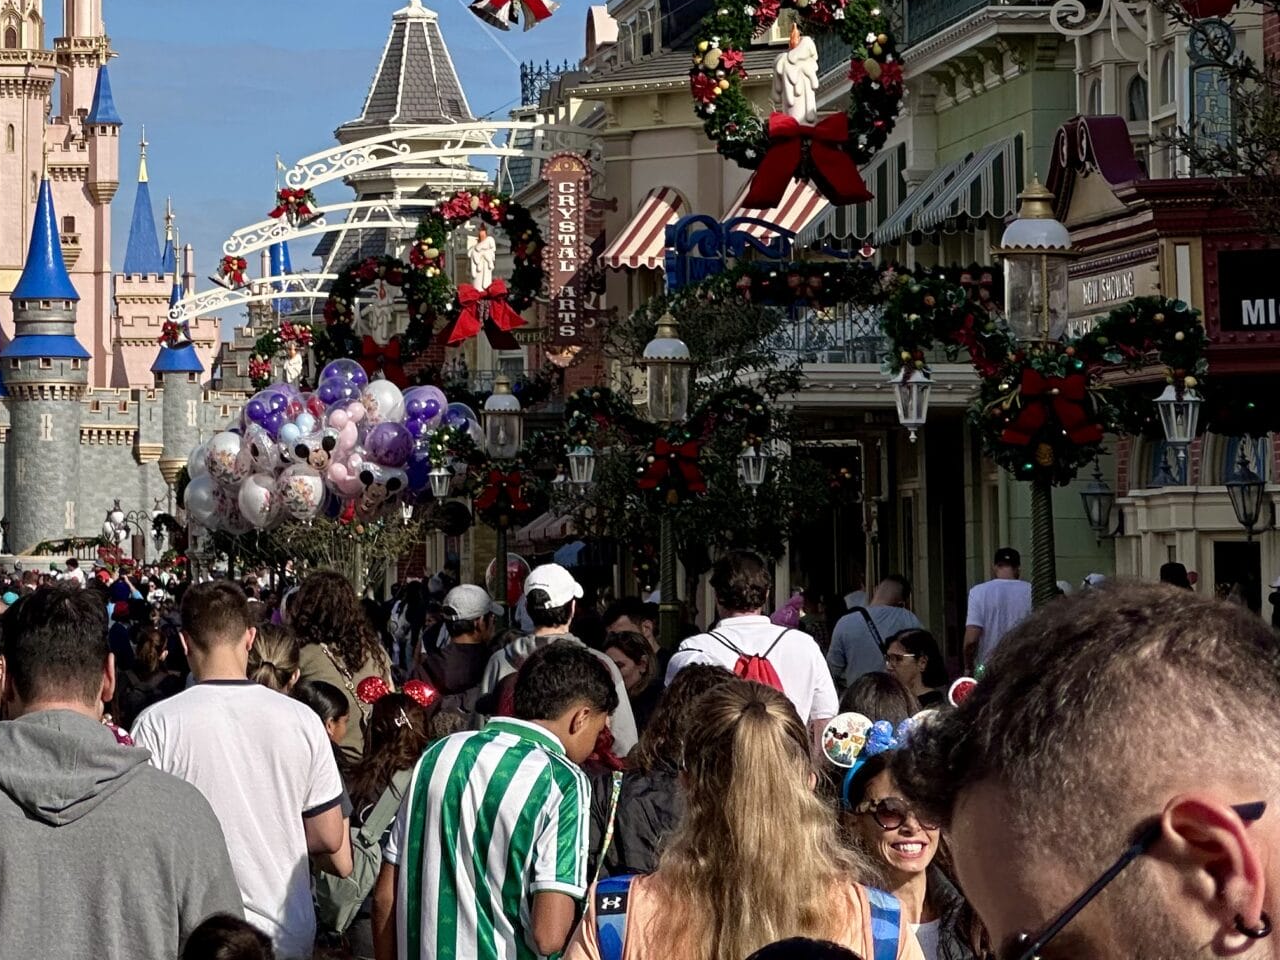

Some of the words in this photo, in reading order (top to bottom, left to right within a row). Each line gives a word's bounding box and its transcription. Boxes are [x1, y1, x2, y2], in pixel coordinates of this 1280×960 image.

[557, 182, 577, 272] CRYSTAL
[1082, 281, 1099, 305] NOW
[1101, 271, 1134, 302] SHOWING
[558, 285, 577, 337] ARTS
[1241, 298, 1280, 326] MI
